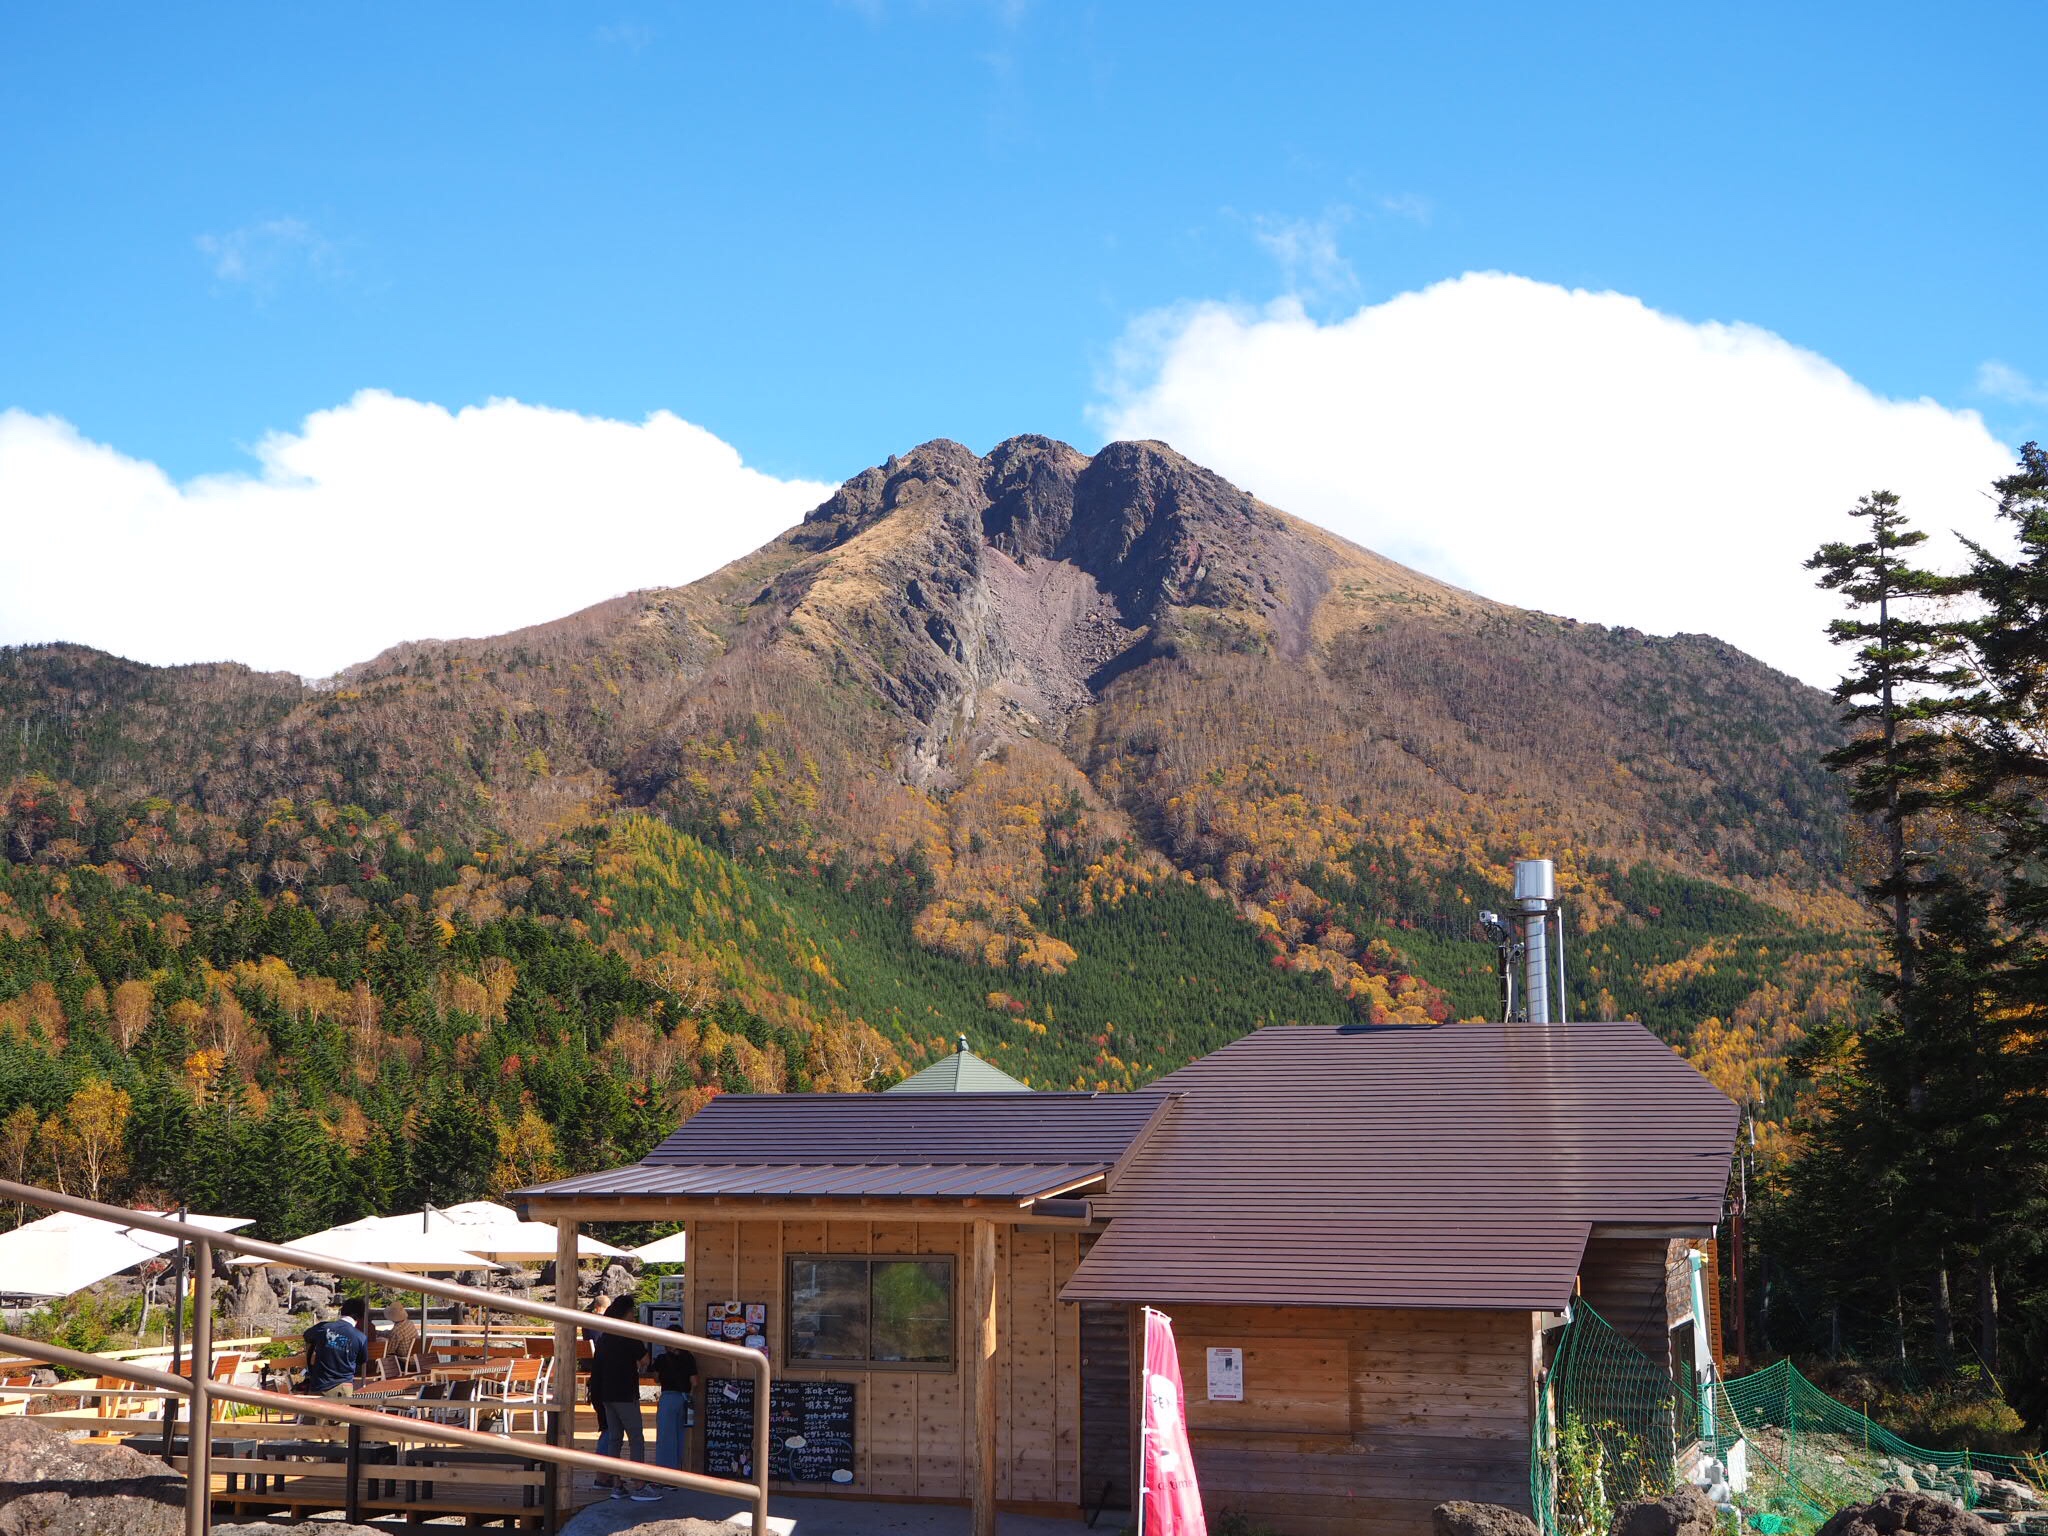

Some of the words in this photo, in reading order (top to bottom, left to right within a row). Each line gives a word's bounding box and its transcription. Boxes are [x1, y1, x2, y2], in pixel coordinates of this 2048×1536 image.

[804, 1387, 838, 1395] ボロネーゼ
[805, 1400, 831, 1409] 明太子
